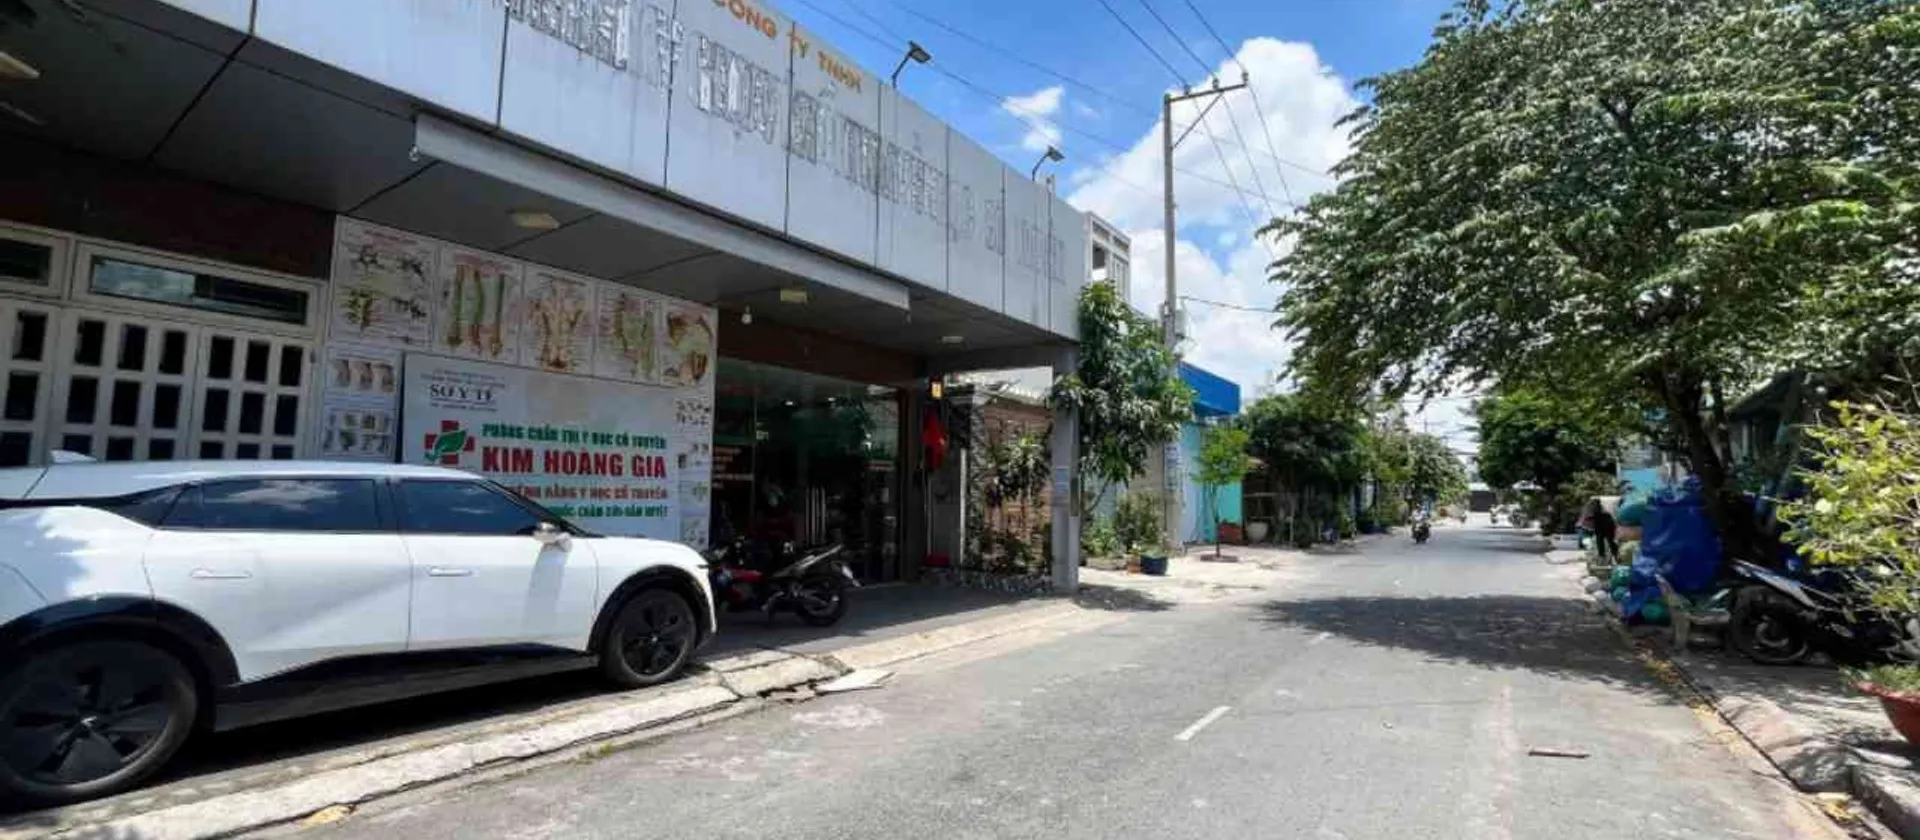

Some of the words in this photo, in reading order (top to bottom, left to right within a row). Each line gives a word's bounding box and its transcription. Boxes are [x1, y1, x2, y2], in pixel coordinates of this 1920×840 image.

[481, 446, 534, 472] KIM
[544, 446, 624, 477] HOÀNG
[631, 453, 667, 478] GIA
